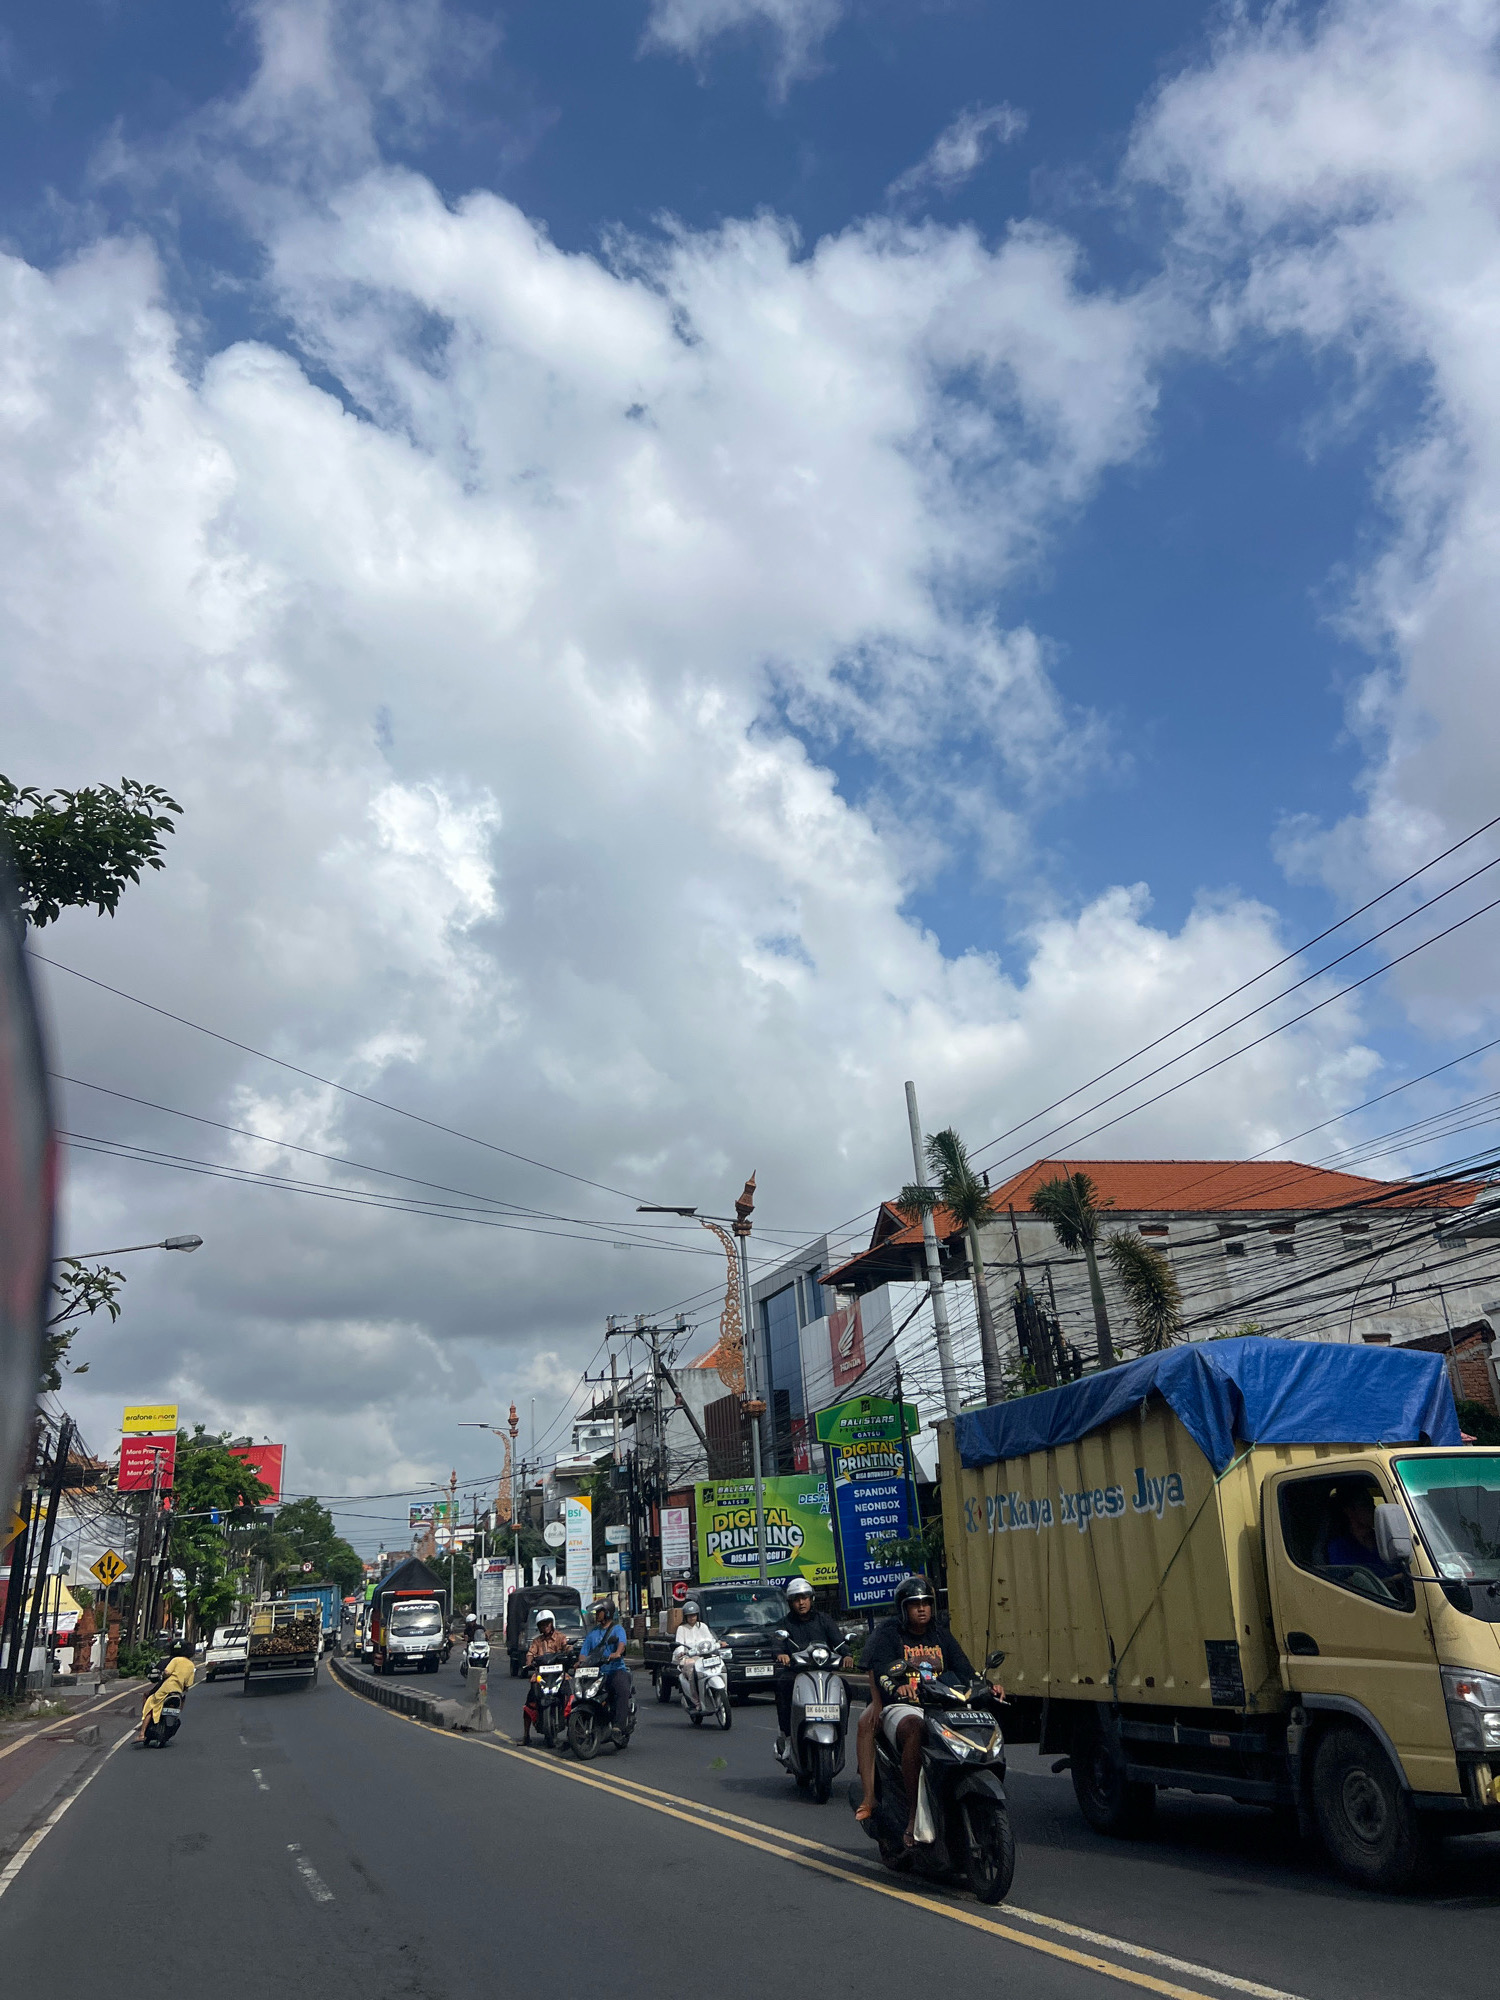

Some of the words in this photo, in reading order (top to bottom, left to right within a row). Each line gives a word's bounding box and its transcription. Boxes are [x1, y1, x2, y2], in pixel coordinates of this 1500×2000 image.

[840, 1357, 862, 1372] HONDA
[840, 1419, 862, 1427] BALI
[864, 1416, 894, 1424] STARS
[843, 1442, 896, 1458] DIGITAL
[839, 1453, 904, 1474] PRINTING
[739, 1484, 766, 1492] STAS
[854, 1486, 898, 1498] SPANDUK
[855, 1500, 900, 1512] NEONBOX
[568, 1509, 581, 1517] BSI
[860, 1515, 898, 1526] BROSUR
[865, 1530, 897, 1540] STIKER
[731, 1554, 746, 1563] BISA
[748, 1551, 780, 1562] DITGGU
[863, 1572, 910, 1585] SOUVENIR
[854, 1589, 886, 1601] HURUF
